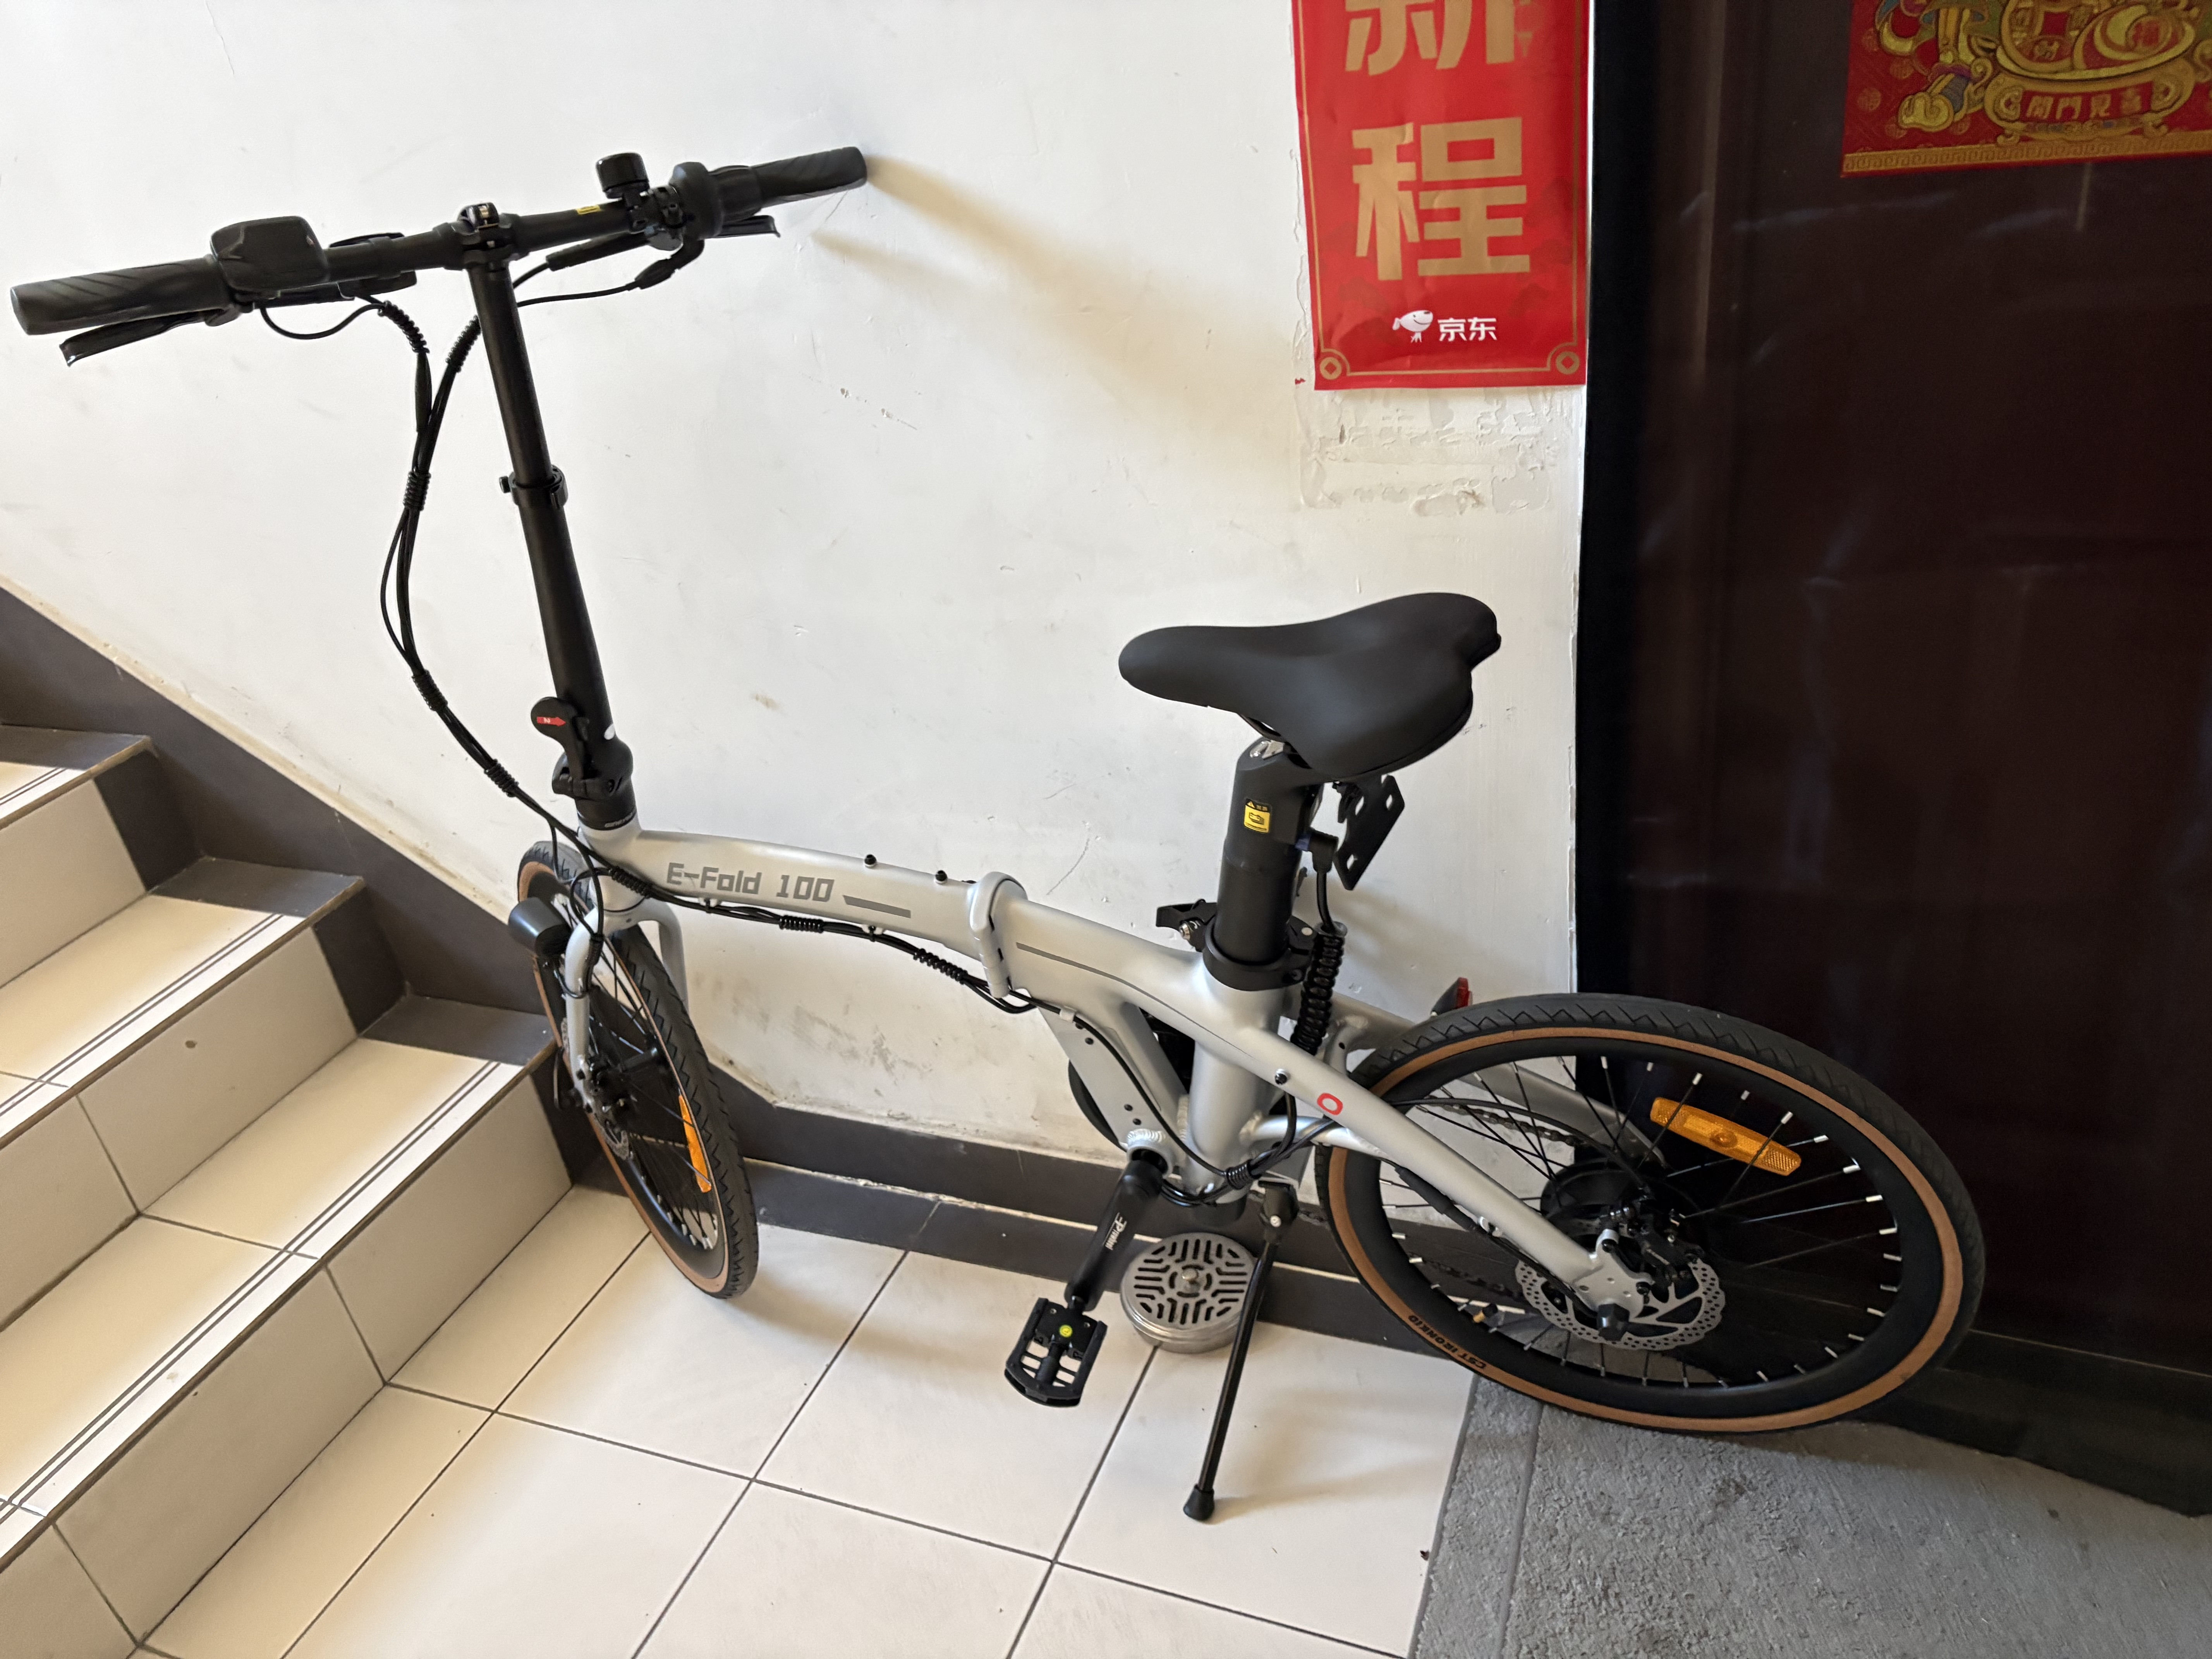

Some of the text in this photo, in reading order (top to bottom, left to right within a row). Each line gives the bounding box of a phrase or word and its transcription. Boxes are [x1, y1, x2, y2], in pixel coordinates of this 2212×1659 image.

[1437, 317, 1497, 342] 京东
[667, 862, 835, 902] E-Fold 100
[1458, 1352, 1486, 1369] CST
